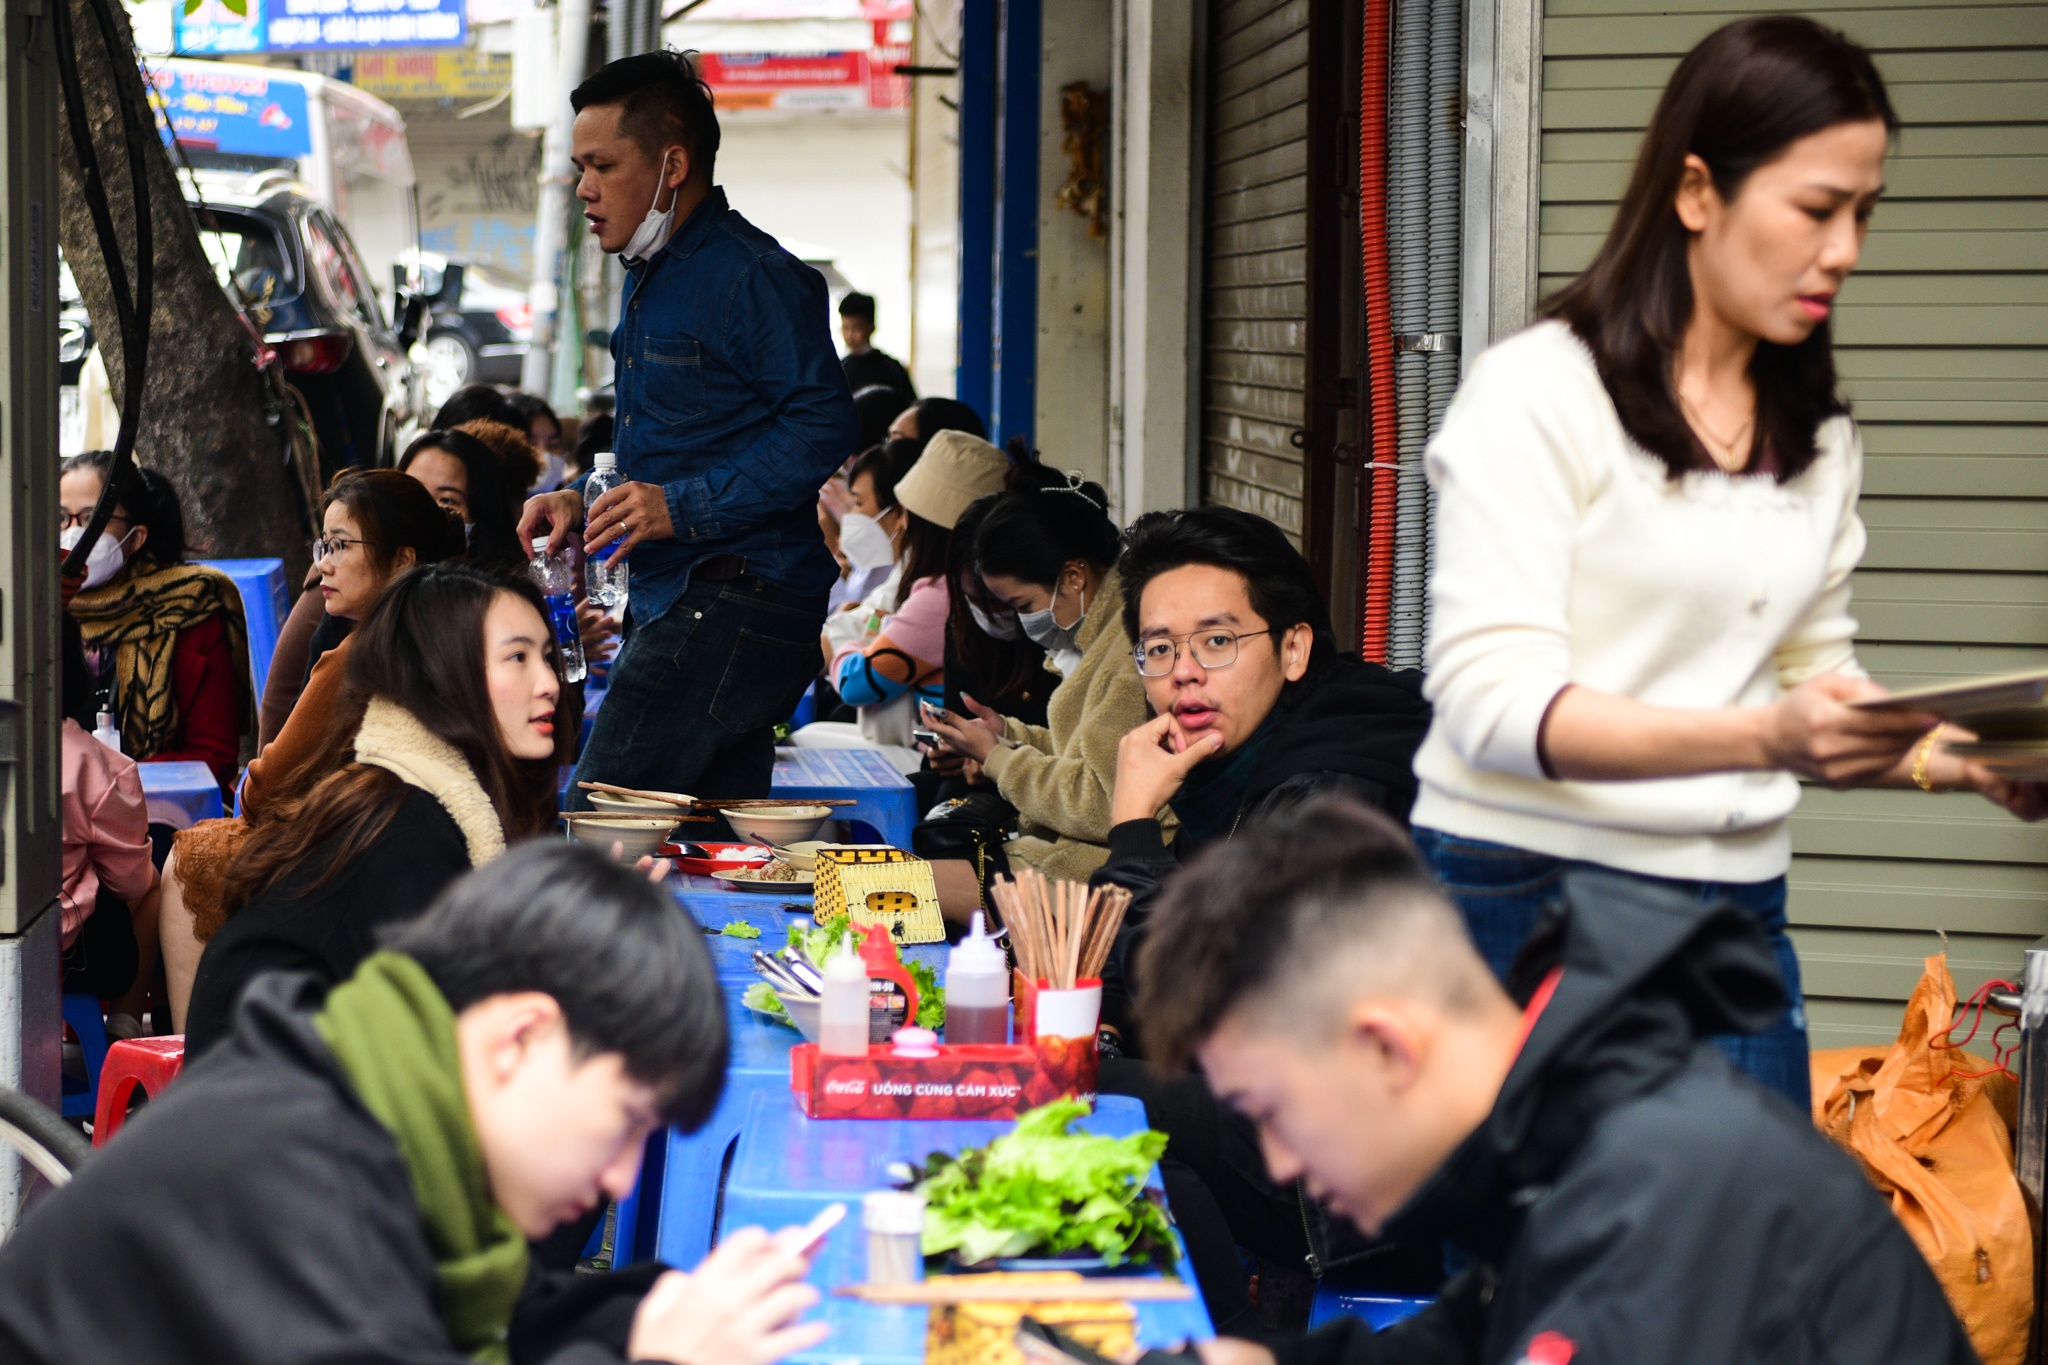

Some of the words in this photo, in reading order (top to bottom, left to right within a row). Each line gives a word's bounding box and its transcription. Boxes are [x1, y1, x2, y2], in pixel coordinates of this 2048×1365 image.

[870, 981, 895, 992] IN-SU
[873, 1080, 912, 1096] UỐNG
[915, 1083, 953, 1097] CÙNG
